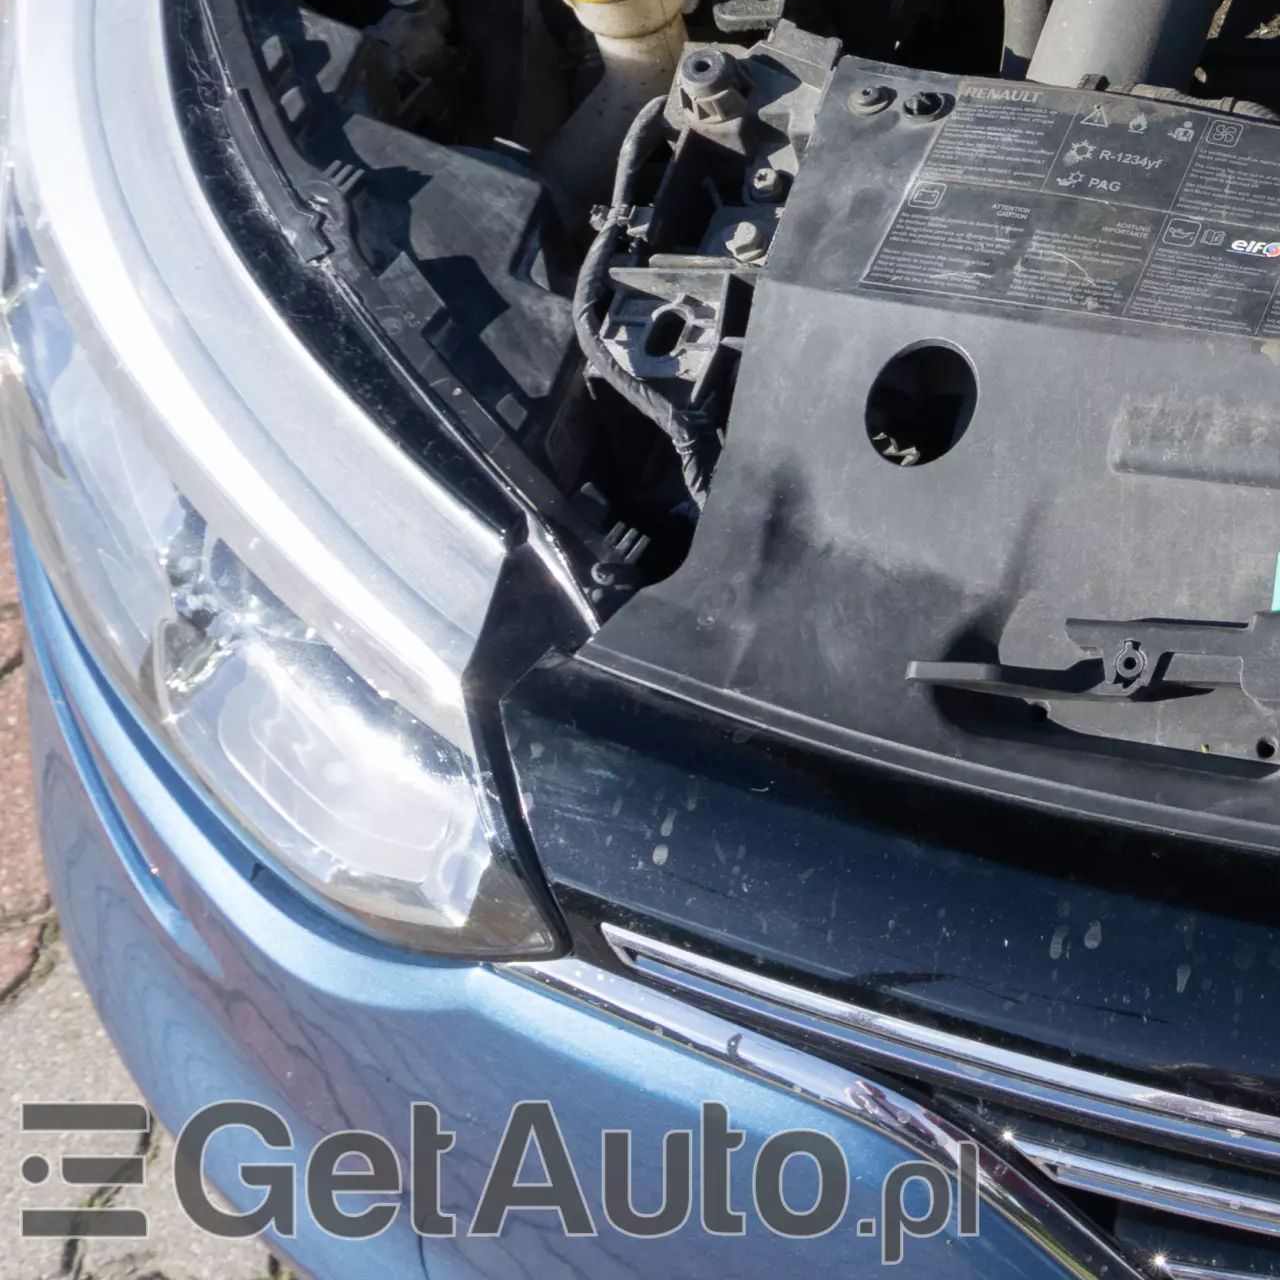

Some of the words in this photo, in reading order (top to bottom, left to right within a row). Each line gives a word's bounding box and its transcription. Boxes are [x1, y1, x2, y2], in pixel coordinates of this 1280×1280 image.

[965, 86, 1043, 103] RENAULT
[1099, 147, 1162, 170] R-1234yf
[1088, 177, 1121, 192] PAG
[989, 202, 1031, 214] ATTENTION
[994, 209, 1028, 220] CAUTION
[1100, 226, 1149, 238] IMPORTANTE
[1115, 222, 1151, 232] ACHTUNG
